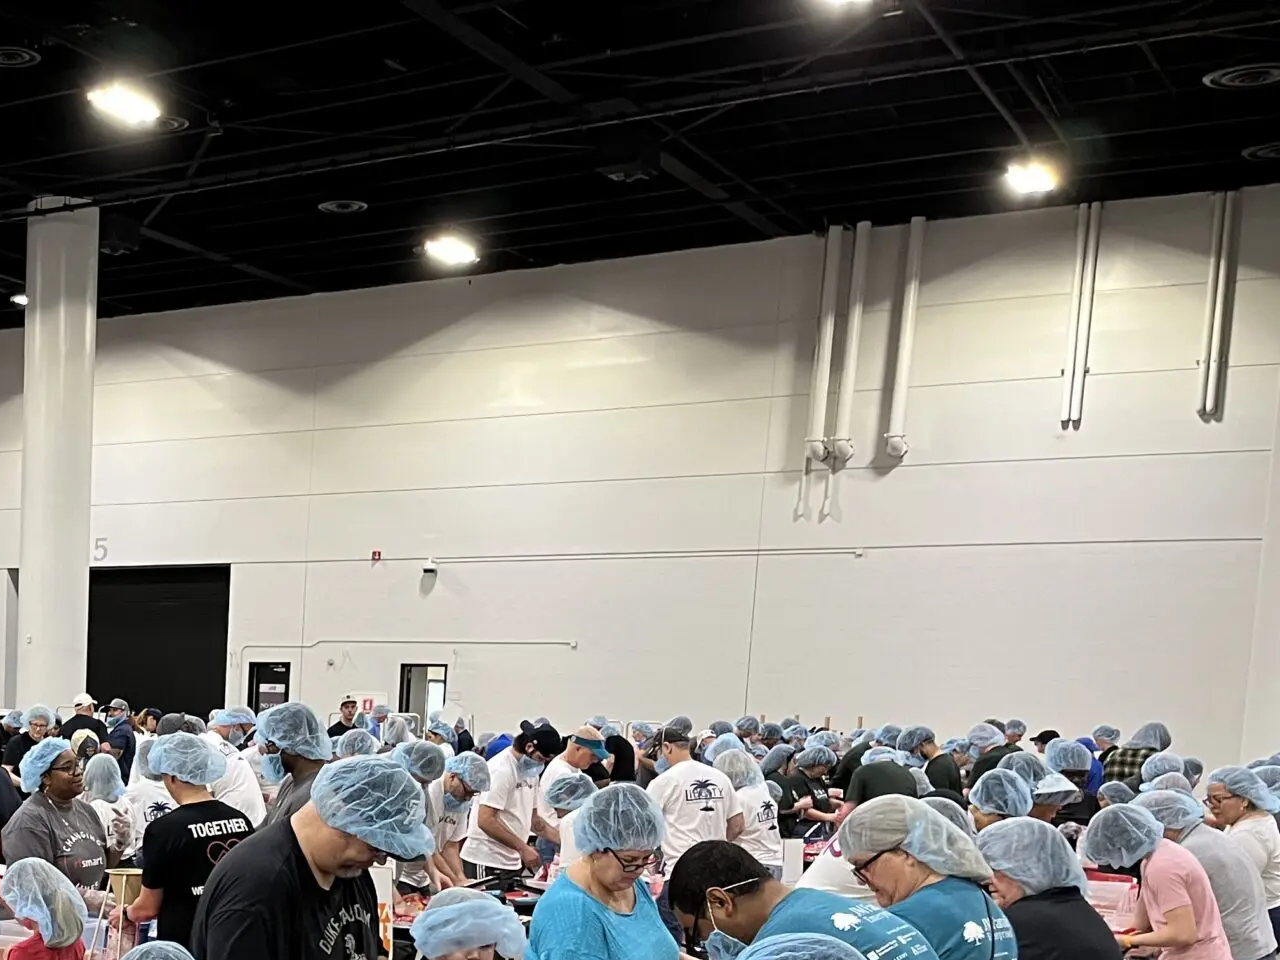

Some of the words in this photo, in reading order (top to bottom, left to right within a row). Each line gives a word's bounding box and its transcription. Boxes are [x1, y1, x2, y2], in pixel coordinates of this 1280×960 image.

[93, 537, 109, 562] 5
[188, 818, 249, 838] TOGETHER
[63, 831, 102, 852] CHANGING
